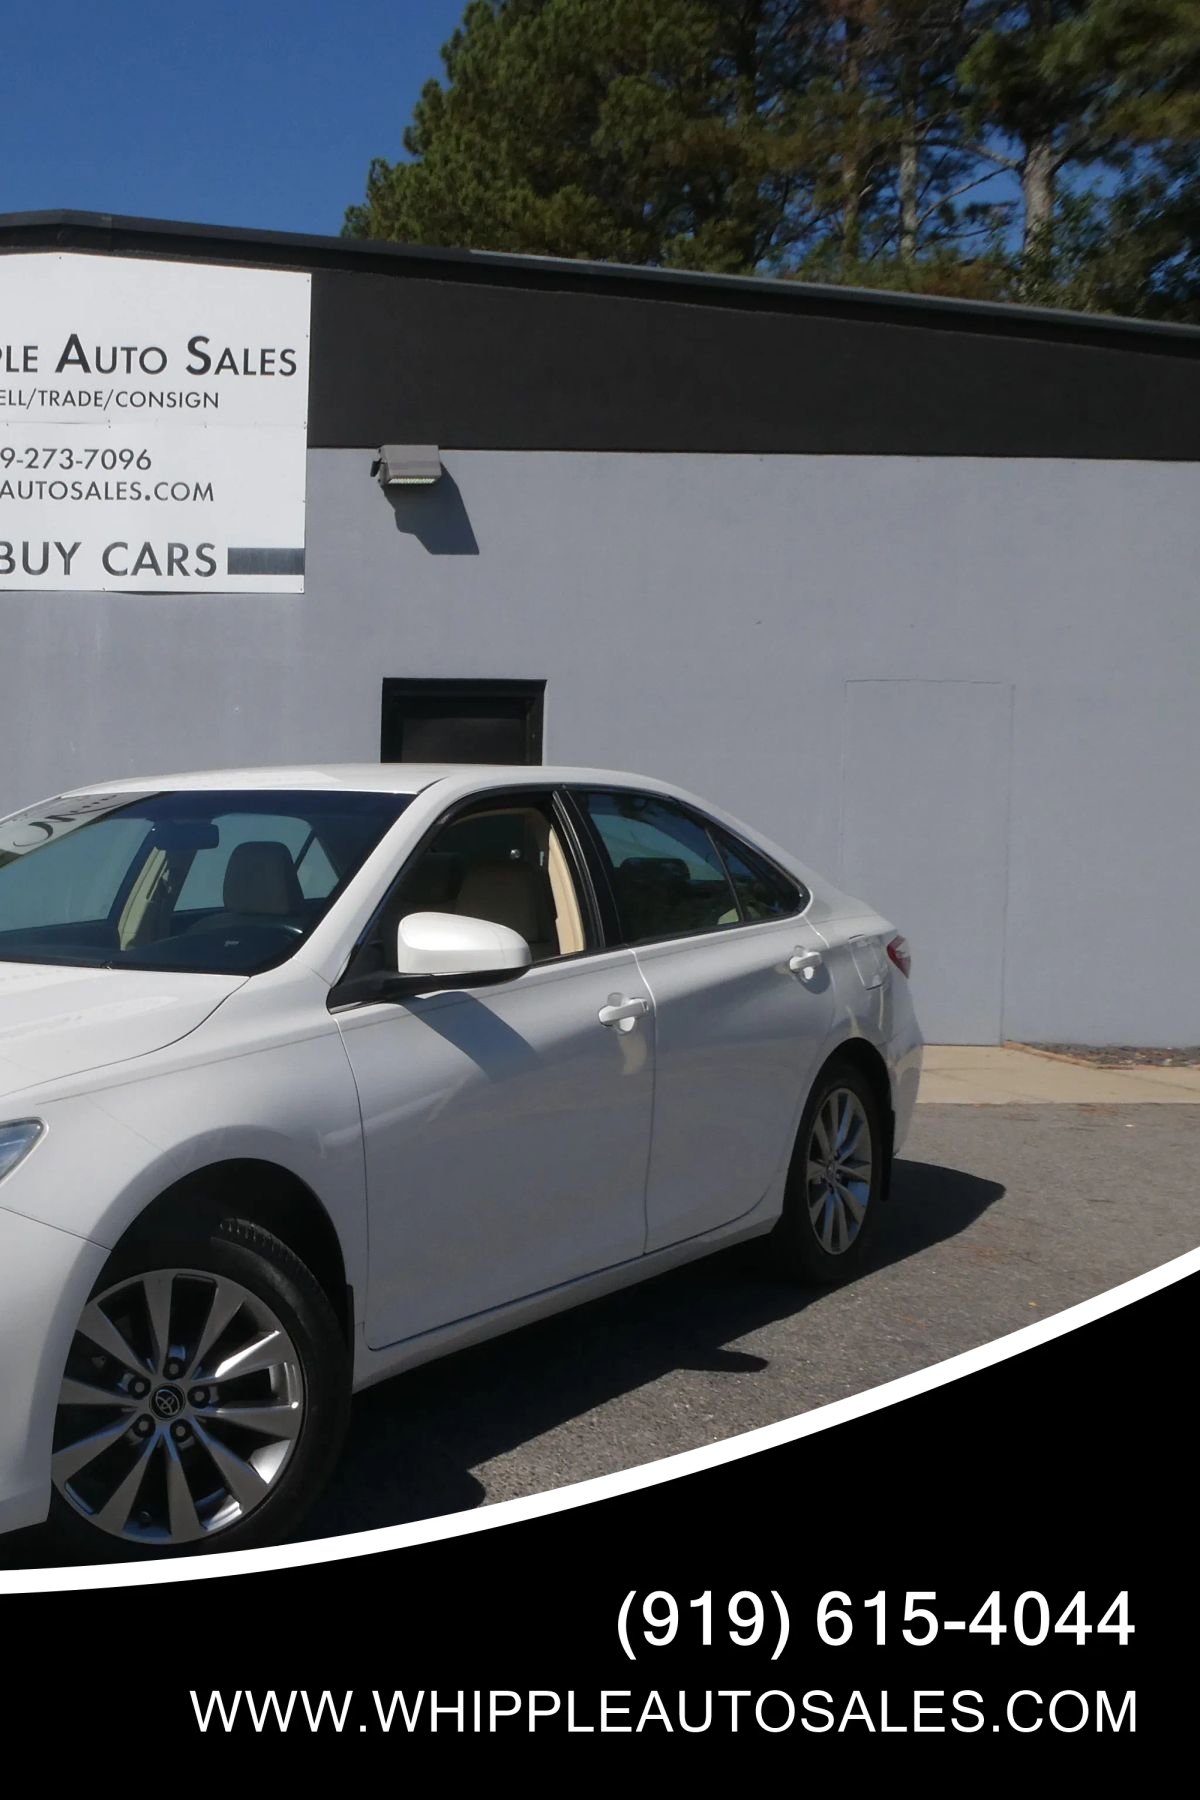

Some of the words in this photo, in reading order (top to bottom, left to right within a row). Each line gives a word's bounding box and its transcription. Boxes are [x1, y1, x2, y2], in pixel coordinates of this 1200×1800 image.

[55, 333, 168, 375] AUTO
[186, 335, 297, 377] SALES
[102, 541, 217, 578] CARS
